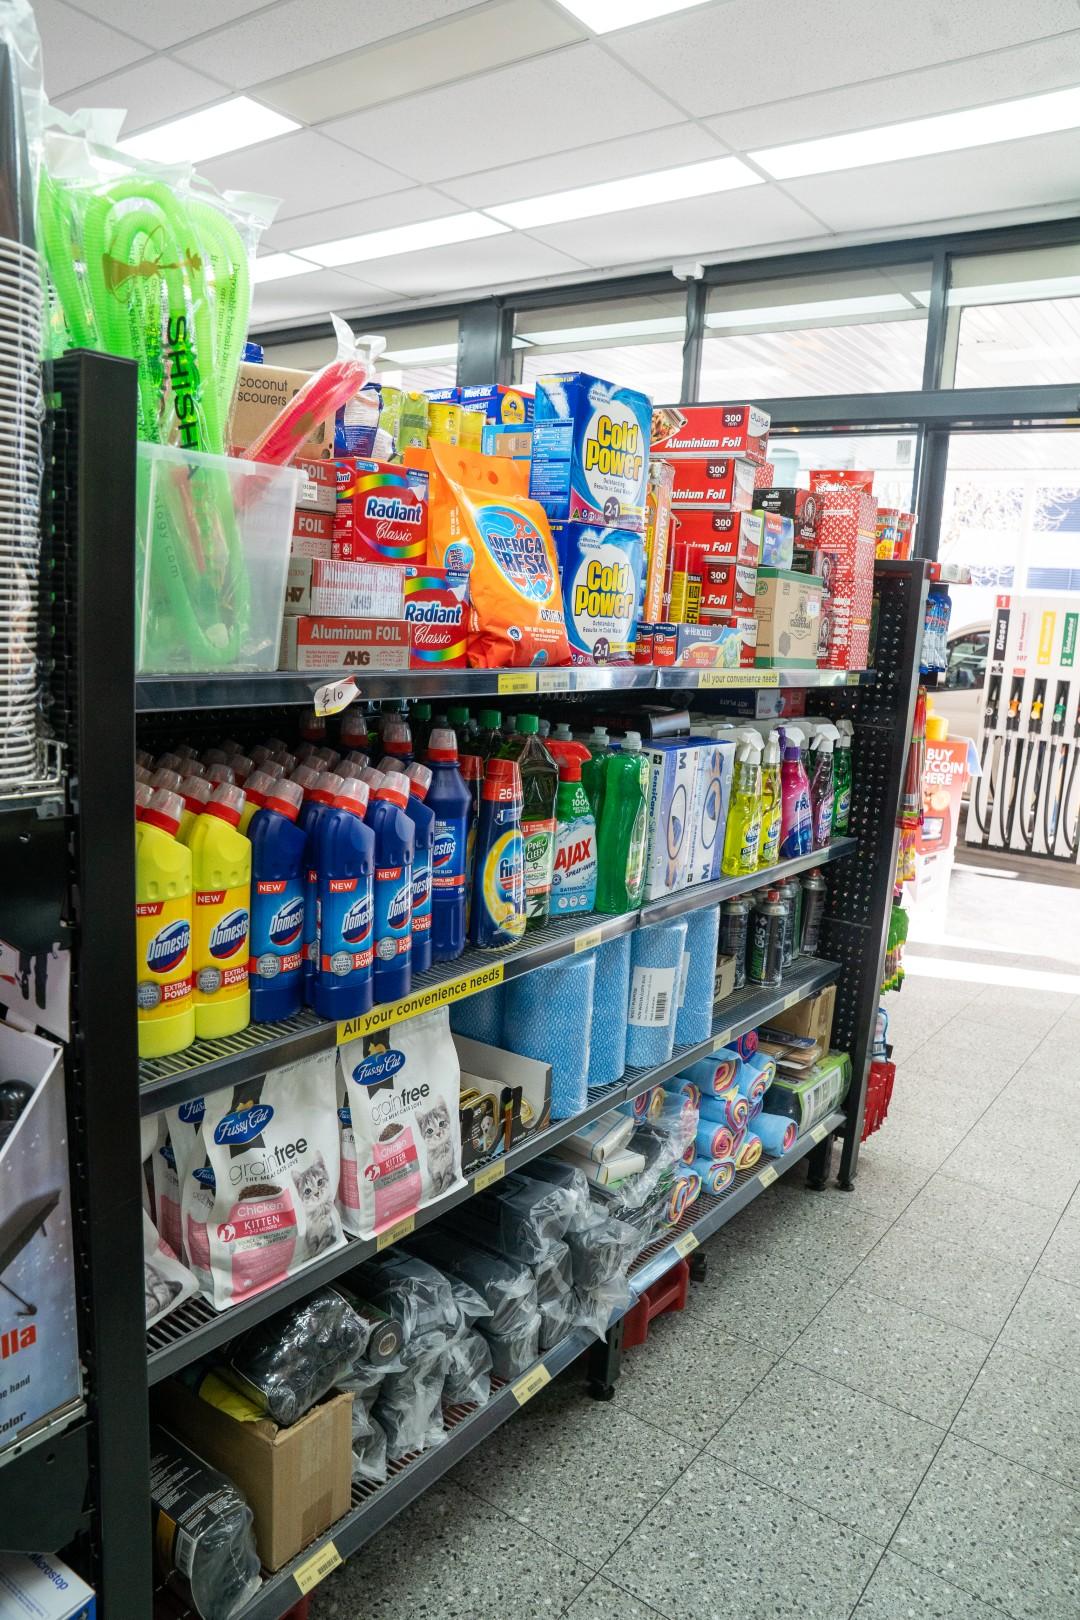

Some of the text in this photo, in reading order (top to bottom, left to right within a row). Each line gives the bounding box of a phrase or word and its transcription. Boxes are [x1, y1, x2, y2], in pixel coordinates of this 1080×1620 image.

[239, 377, 288, 391] coconut
[238, 391, 287, 406] scourers
[725, 414, 741, 422] 300
[598, 415, 638, 454] Cold
[665, 437, 741, 448] Aluminium Foil
[586, 438, 642, 481] Power
[301, 464, 327, 480] FOIL
[709, 466, 725, 474] 300
[706, 489, 726, 499] Foil
[366, 498, 422, 523] Radiant
[298, 518, 324, 533] FOIL
[376, 520, 412, 541] Classic
[715, 519, 731, 527] 300
[488, 535, 543, 553] AMERICA
[712, 542, 732, 552] Foil
[494, 550, 548, 574] FRESH
[588, 561, 628, 592] Cold
[710, 572, 726, 580] 300
[575, 585, 633, 618] Power
[708, 595, 726, 605] Foil
[405, 602, 461, 623] Radiant
[311, 624, 401, 640] Aluminum FOIL
[415, 626, 451, 644] Classic
[996, 619, 1007, 650] Diesel
[702, 672, 778, 685] All your convenience needs
[927, 749, 953, 761] BUY
[925, 762, 963, 773] TCOIN
[499, 789, 512, 799] 26
[649, 769, 659, 817] SensiCare
[433, 841, 456, 855] estos
[553, 837, 592, 873] AJAX
[198, 895, 220, 903] NEW
[755, 928, 766, 948] GAS
[224, 968, 244, 977] EXTRA
[164, 981, 187, 992] EXTRA
[343, 969, 500, 1036] All your convenience needs
[357, 1063, 384, 1082] Fussy
[218, 1108, 268, 1142] Fussy Cat
[237, 1202, 283, 1217] Chicken
[245, 1214, 280, 1230] KITTEN
[1, 1325, 36, 1359] lla
[10, 1375, 30, 1393] hand
